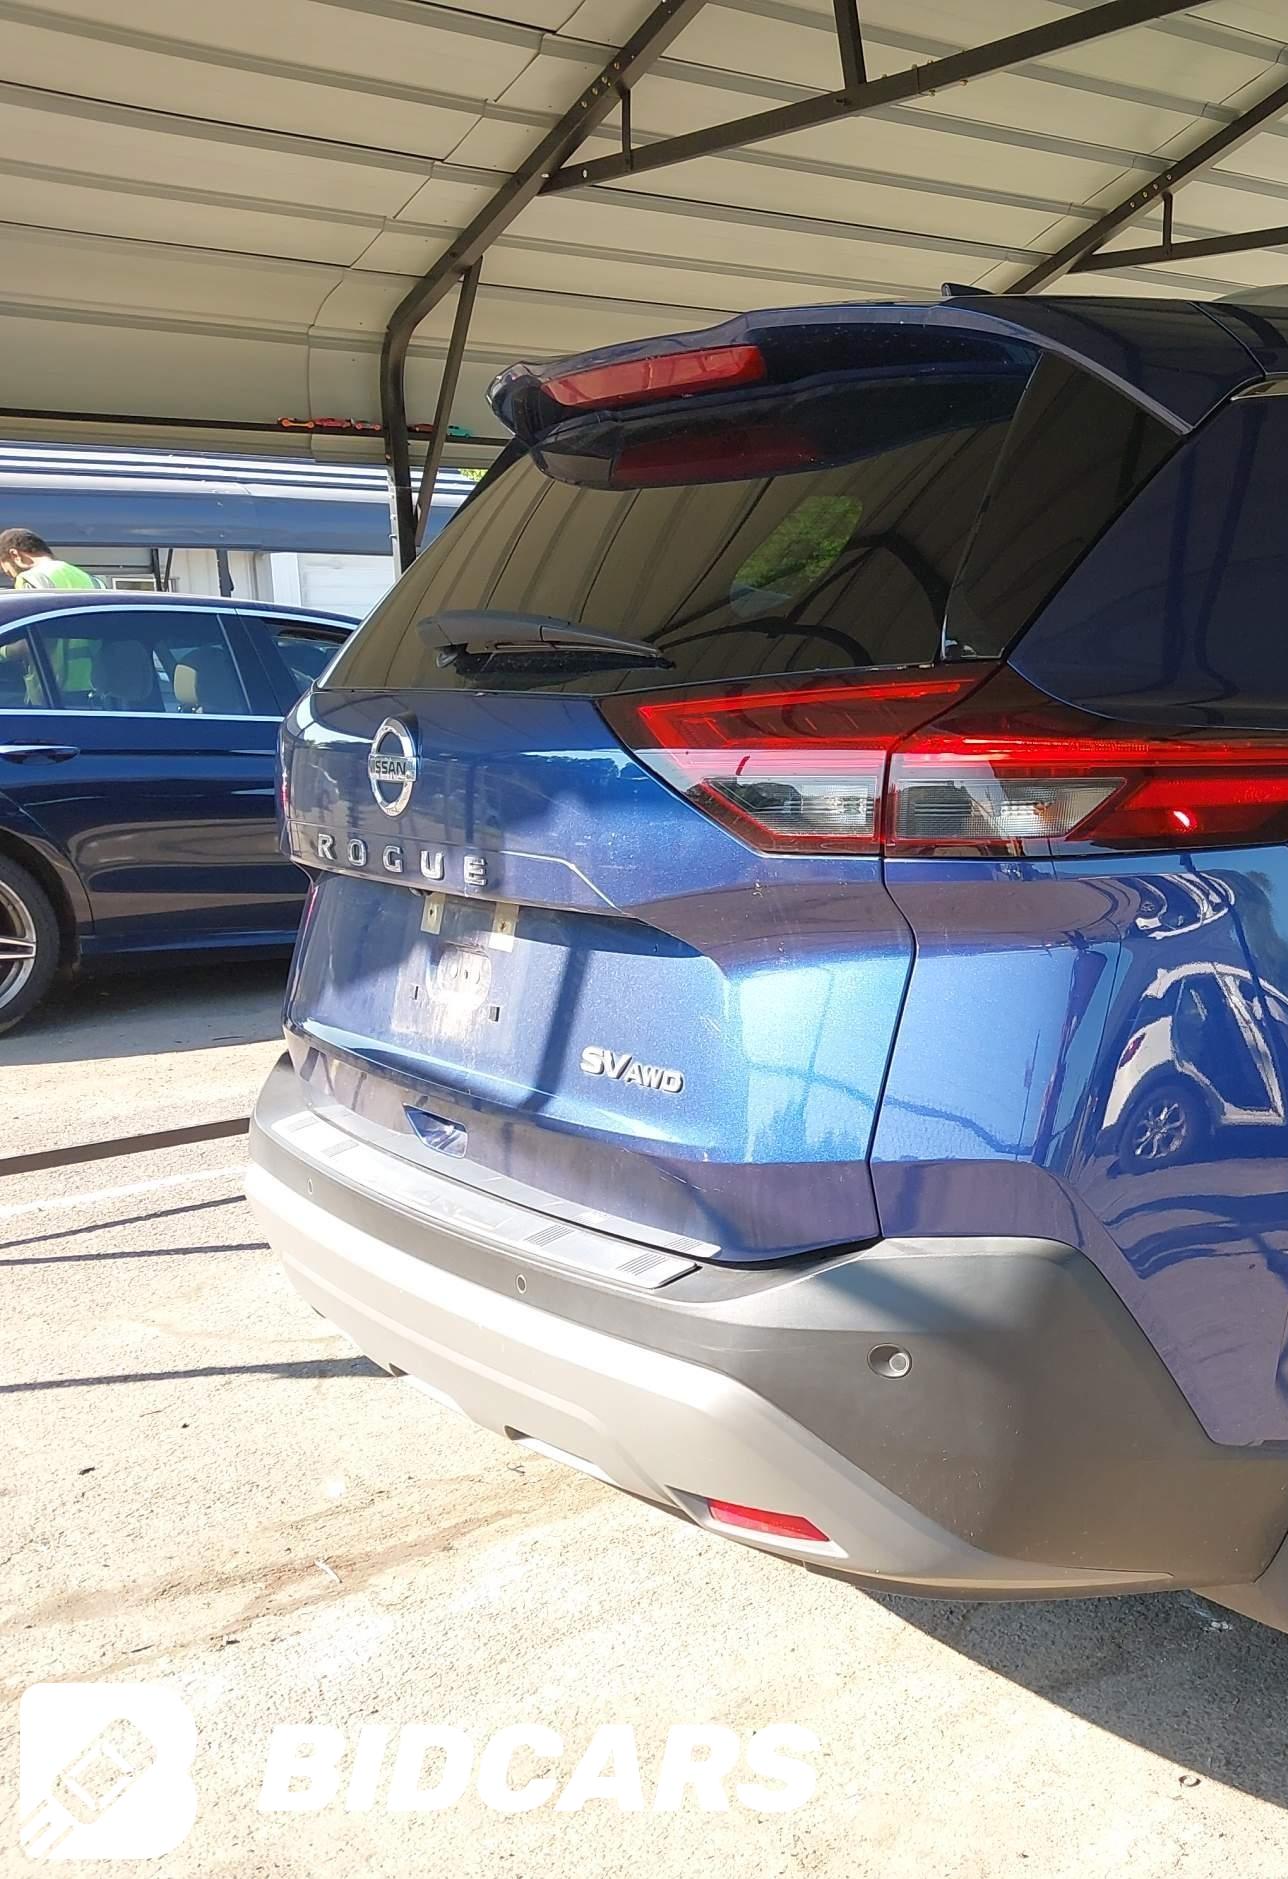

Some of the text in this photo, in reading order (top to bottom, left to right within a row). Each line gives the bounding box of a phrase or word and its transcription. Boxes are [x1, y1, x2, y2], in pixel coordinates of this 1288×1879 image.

[369, 759, 407, 776] SSAN
[317, 833, 488, 886] ROGUE
[580, 1045, 684, 1094] SV AWD
